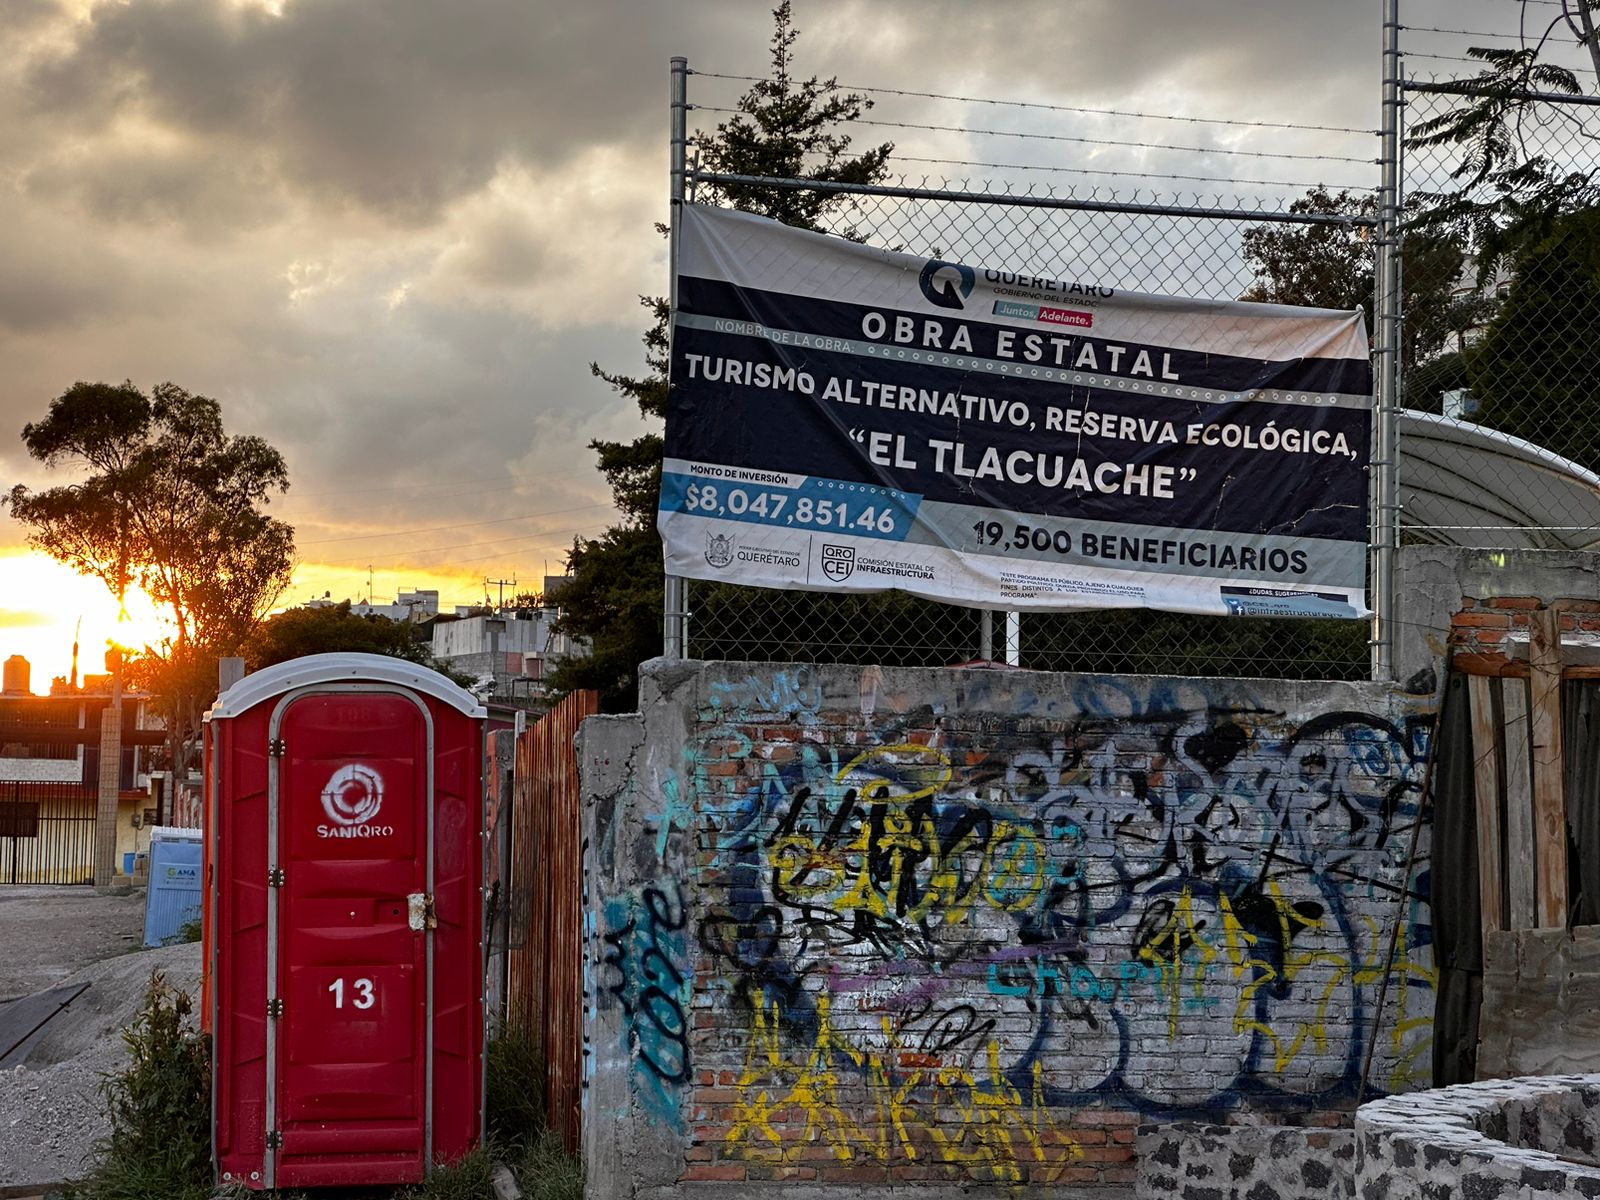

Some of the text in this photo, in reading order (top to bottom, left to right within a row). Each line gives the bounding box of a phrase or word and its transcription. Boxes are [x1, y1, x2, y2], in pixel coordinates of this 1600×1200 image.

[993, 287, 1098, 308] GOBIERNO DEL ESTADO
[1000, 304, 1089, 326] Juntos, Adelante.
[715, 319, 855, 354] NOMBRE DE LA OBRA:
[862, 311, 1181, 381] OBRA ESTATAL
[685, 353, 1358, 462] TURISMO ALTERNATIVO, RESERVA ECOLÓGICA,
[690, 464, 788, 486] MONTO DE INVERSIÓN
[928, 439, 1197, 499] TLACUACHE”
[685, 483, 895, 534] $8,047,851.46
[737, 550, 800, 567] QUERÉTARO
[825, 547, 853, 559] QRO
[972, 520, 1309, 575] 19,500 BENEFICIARIOS
[824, 560, 850, 576] CEI
[857, 557, 935, 573] COMISIÓN ESTATAL DE
[857, 564, 936, 580] INFRAESTRUCTURA
[1017, 574, 1050, 582] PROGRAMA
[328, 977, 376, 1010] 13
